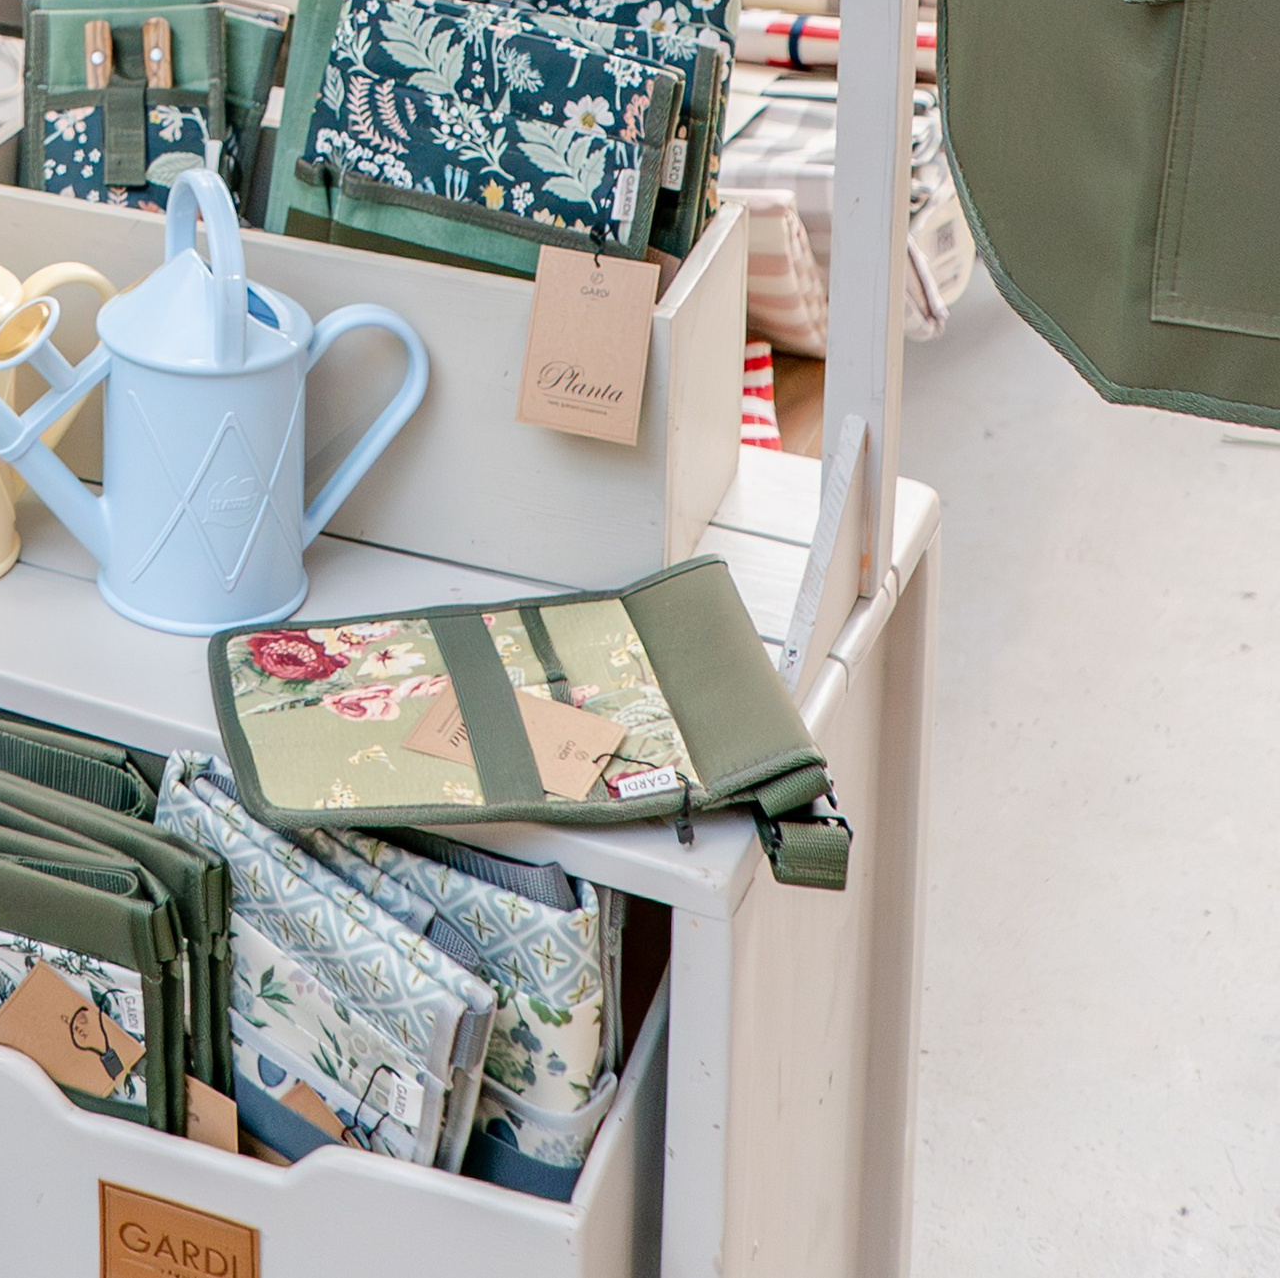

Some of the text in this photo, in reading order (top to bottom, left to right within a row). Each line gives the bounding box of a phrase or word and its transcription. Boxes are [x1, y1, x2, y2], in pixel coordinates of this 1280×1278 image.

[669, 145, 684, 185] GARDI
[622, 174, 636, 218] GARDI
[580, 285, 610, 299] GARDI
[536, 360, 625, 404] Planta
[622, 771, 672, 795] GARDI
[118, 1221, 238, 1278] GARDI
